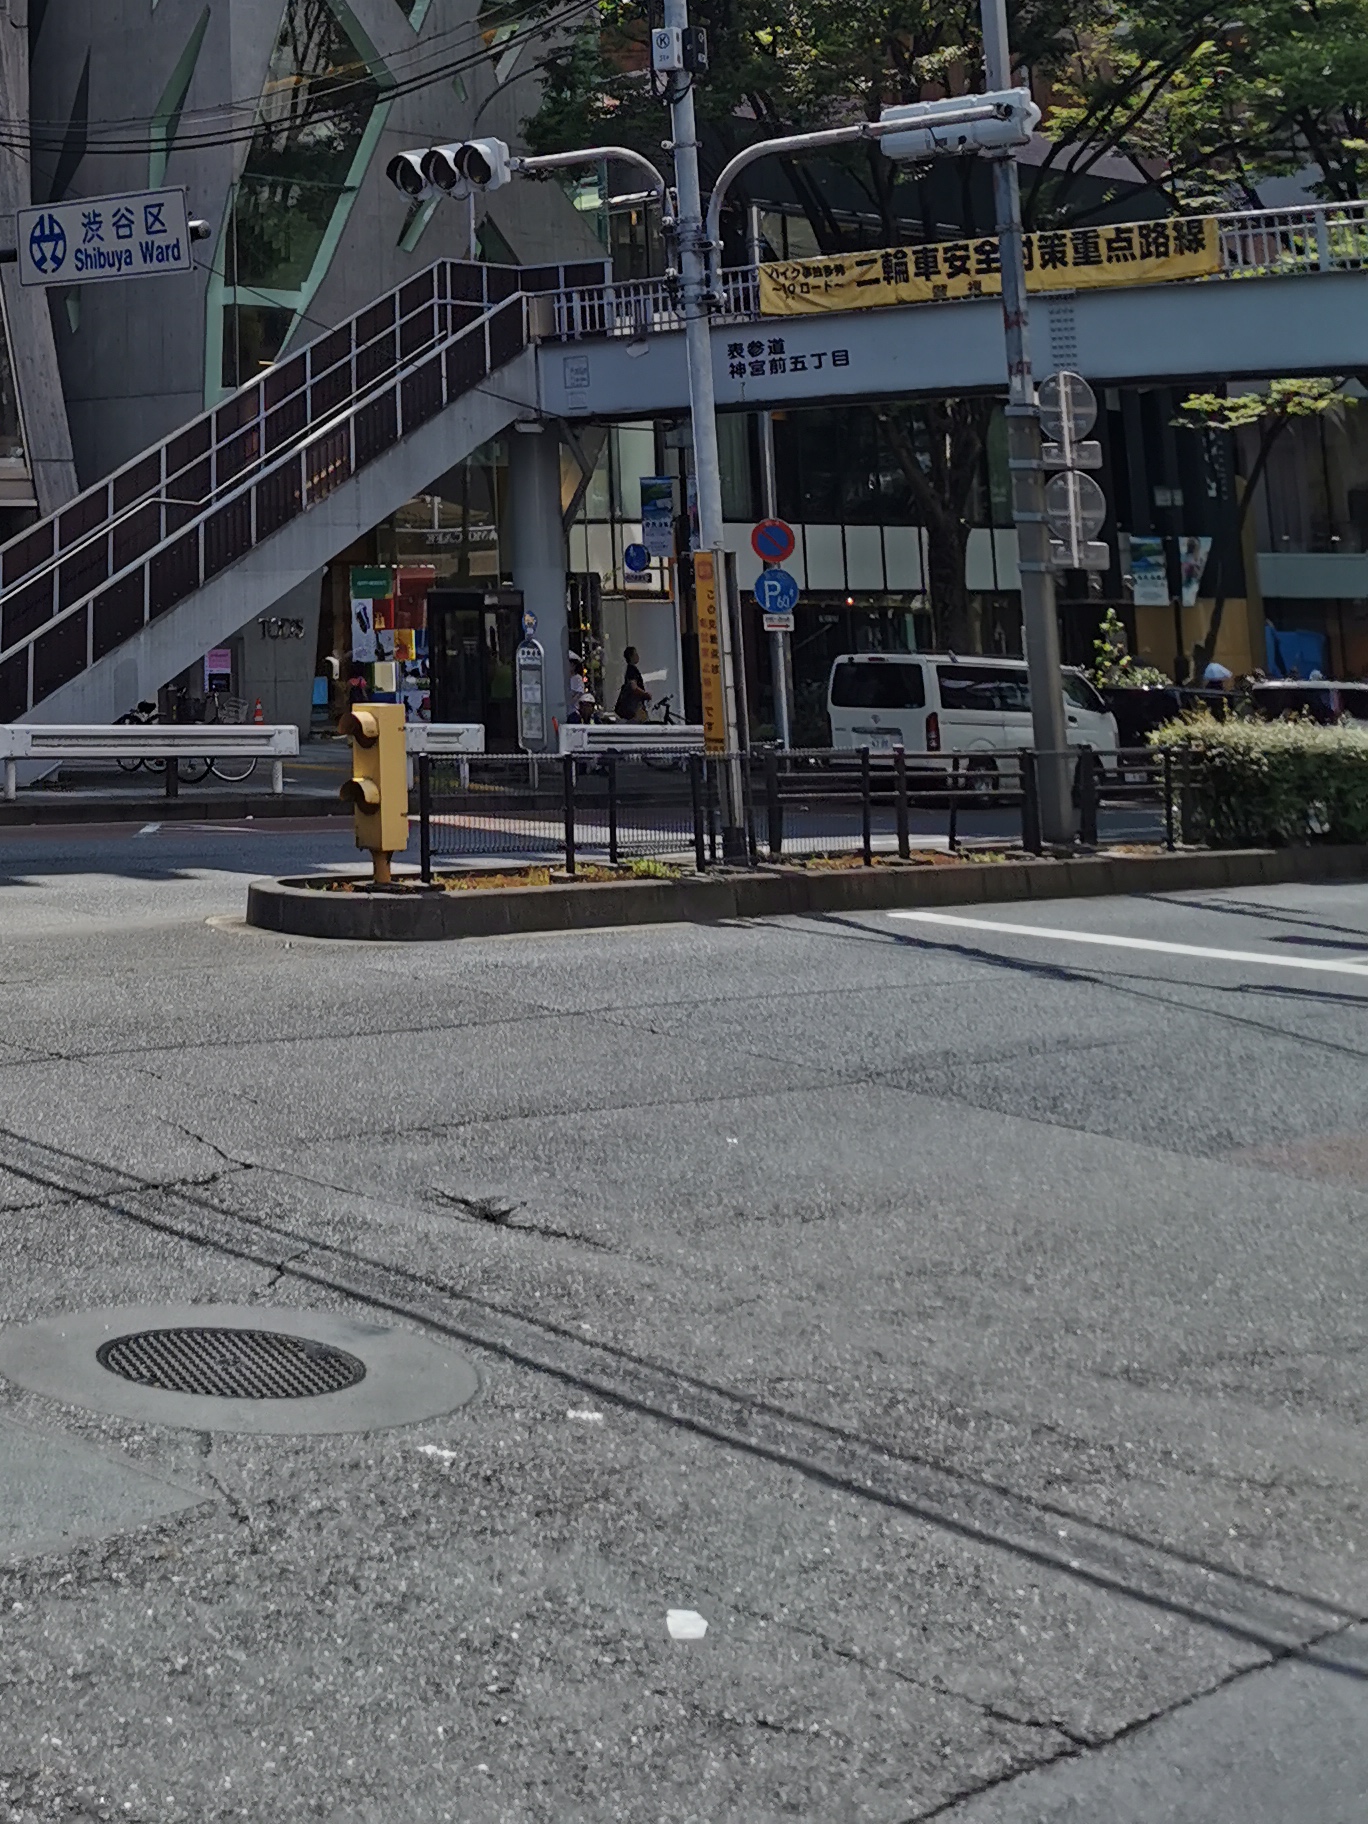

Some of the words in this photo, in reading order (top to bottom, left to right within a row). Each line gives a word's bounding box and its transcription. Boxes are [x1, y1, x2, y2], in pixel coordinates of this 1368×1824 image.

[81, 202, 168, 245] 渋谷区
[74, 247, 133, 272] Shibuya
[139, 237, 182, 264] Ward
[727, 338, 785, 360] 表参道
[728, 349, 850, 379] 神宮前五丁目
[764, 580, 781, 609] P
